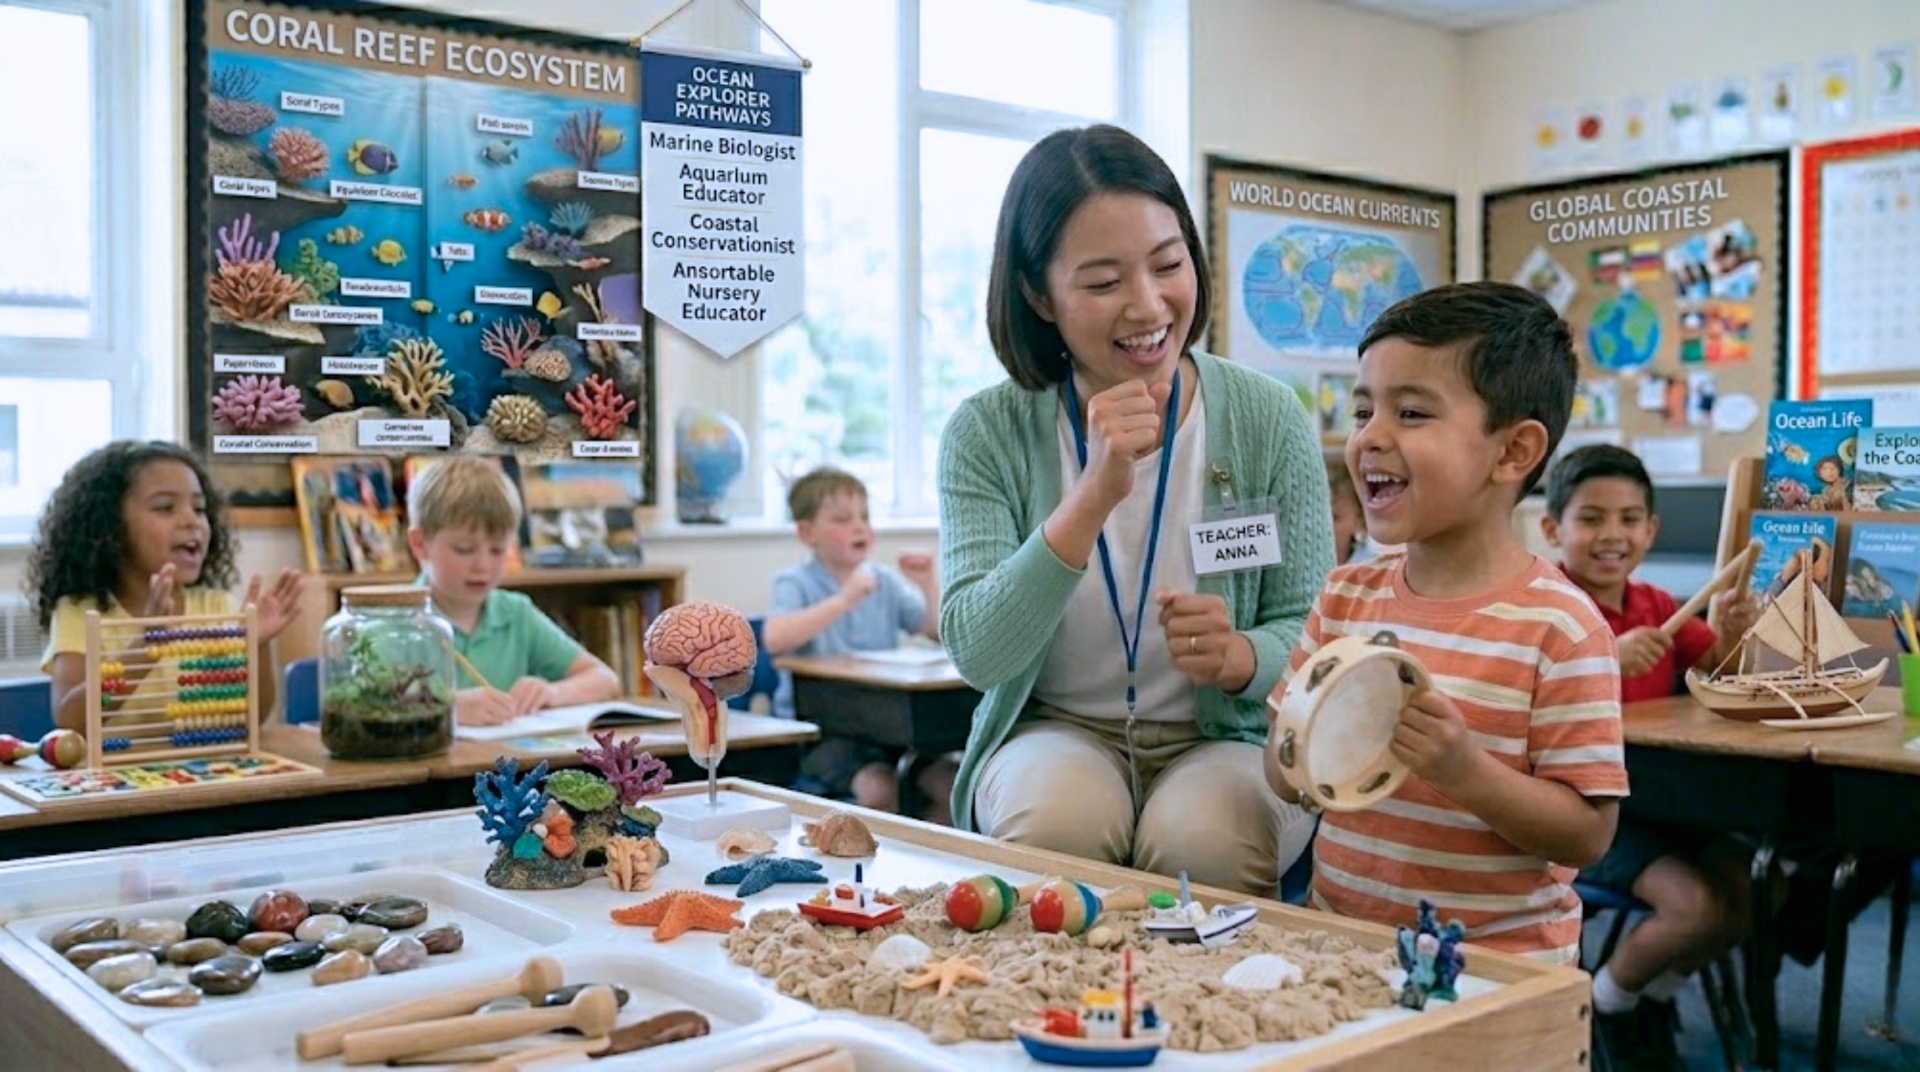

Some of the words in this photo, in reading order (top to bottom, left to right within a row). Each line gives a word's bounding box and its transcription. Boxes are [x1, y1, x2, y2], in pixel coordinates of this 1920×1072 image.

[226, 9, 344, 55] CORAL
[355, 28, 435, 66] REEF
[445, 42, 626, 93] ECOSYSTEM
[692, 66, 754, 88] OCEAN
[676, 84, 770, 108] EXPLORER
[675, 101, 771, 127] PATHWAYS
[650, 131, 713, 153] Marine
[718, 138, 796, 162] Biologist
[683, 184, 766, 205] Educator
[1229, 180, 1294, 208] WORLD
[1298, 191, 1355, 217] OCEAN
[1359, 199, 1440, 229] CURRENTS
[1530, 193, 1616, 222] GLOBAL
[1622, 177, 1728, 210] COASTAL
[690, 213, 759, 233] Coastal
[1547, 205, 1712, 243] COMMUNITIES
[651, 231, 796, 254] Conservationist
[673, 261, 775, 283] Ansortable
[688, 283, 760, 305] Nursery
[682, 302, 767, 322] Educator
[1775, 413, 1827, 429] Ocean
[1832, 411, 1863, 428] Life
[1864, 450, 1890, 465] the
[1196, 523, 1271, 544] TEACHER:
[1215, 544, 1258, 561] ANNA
